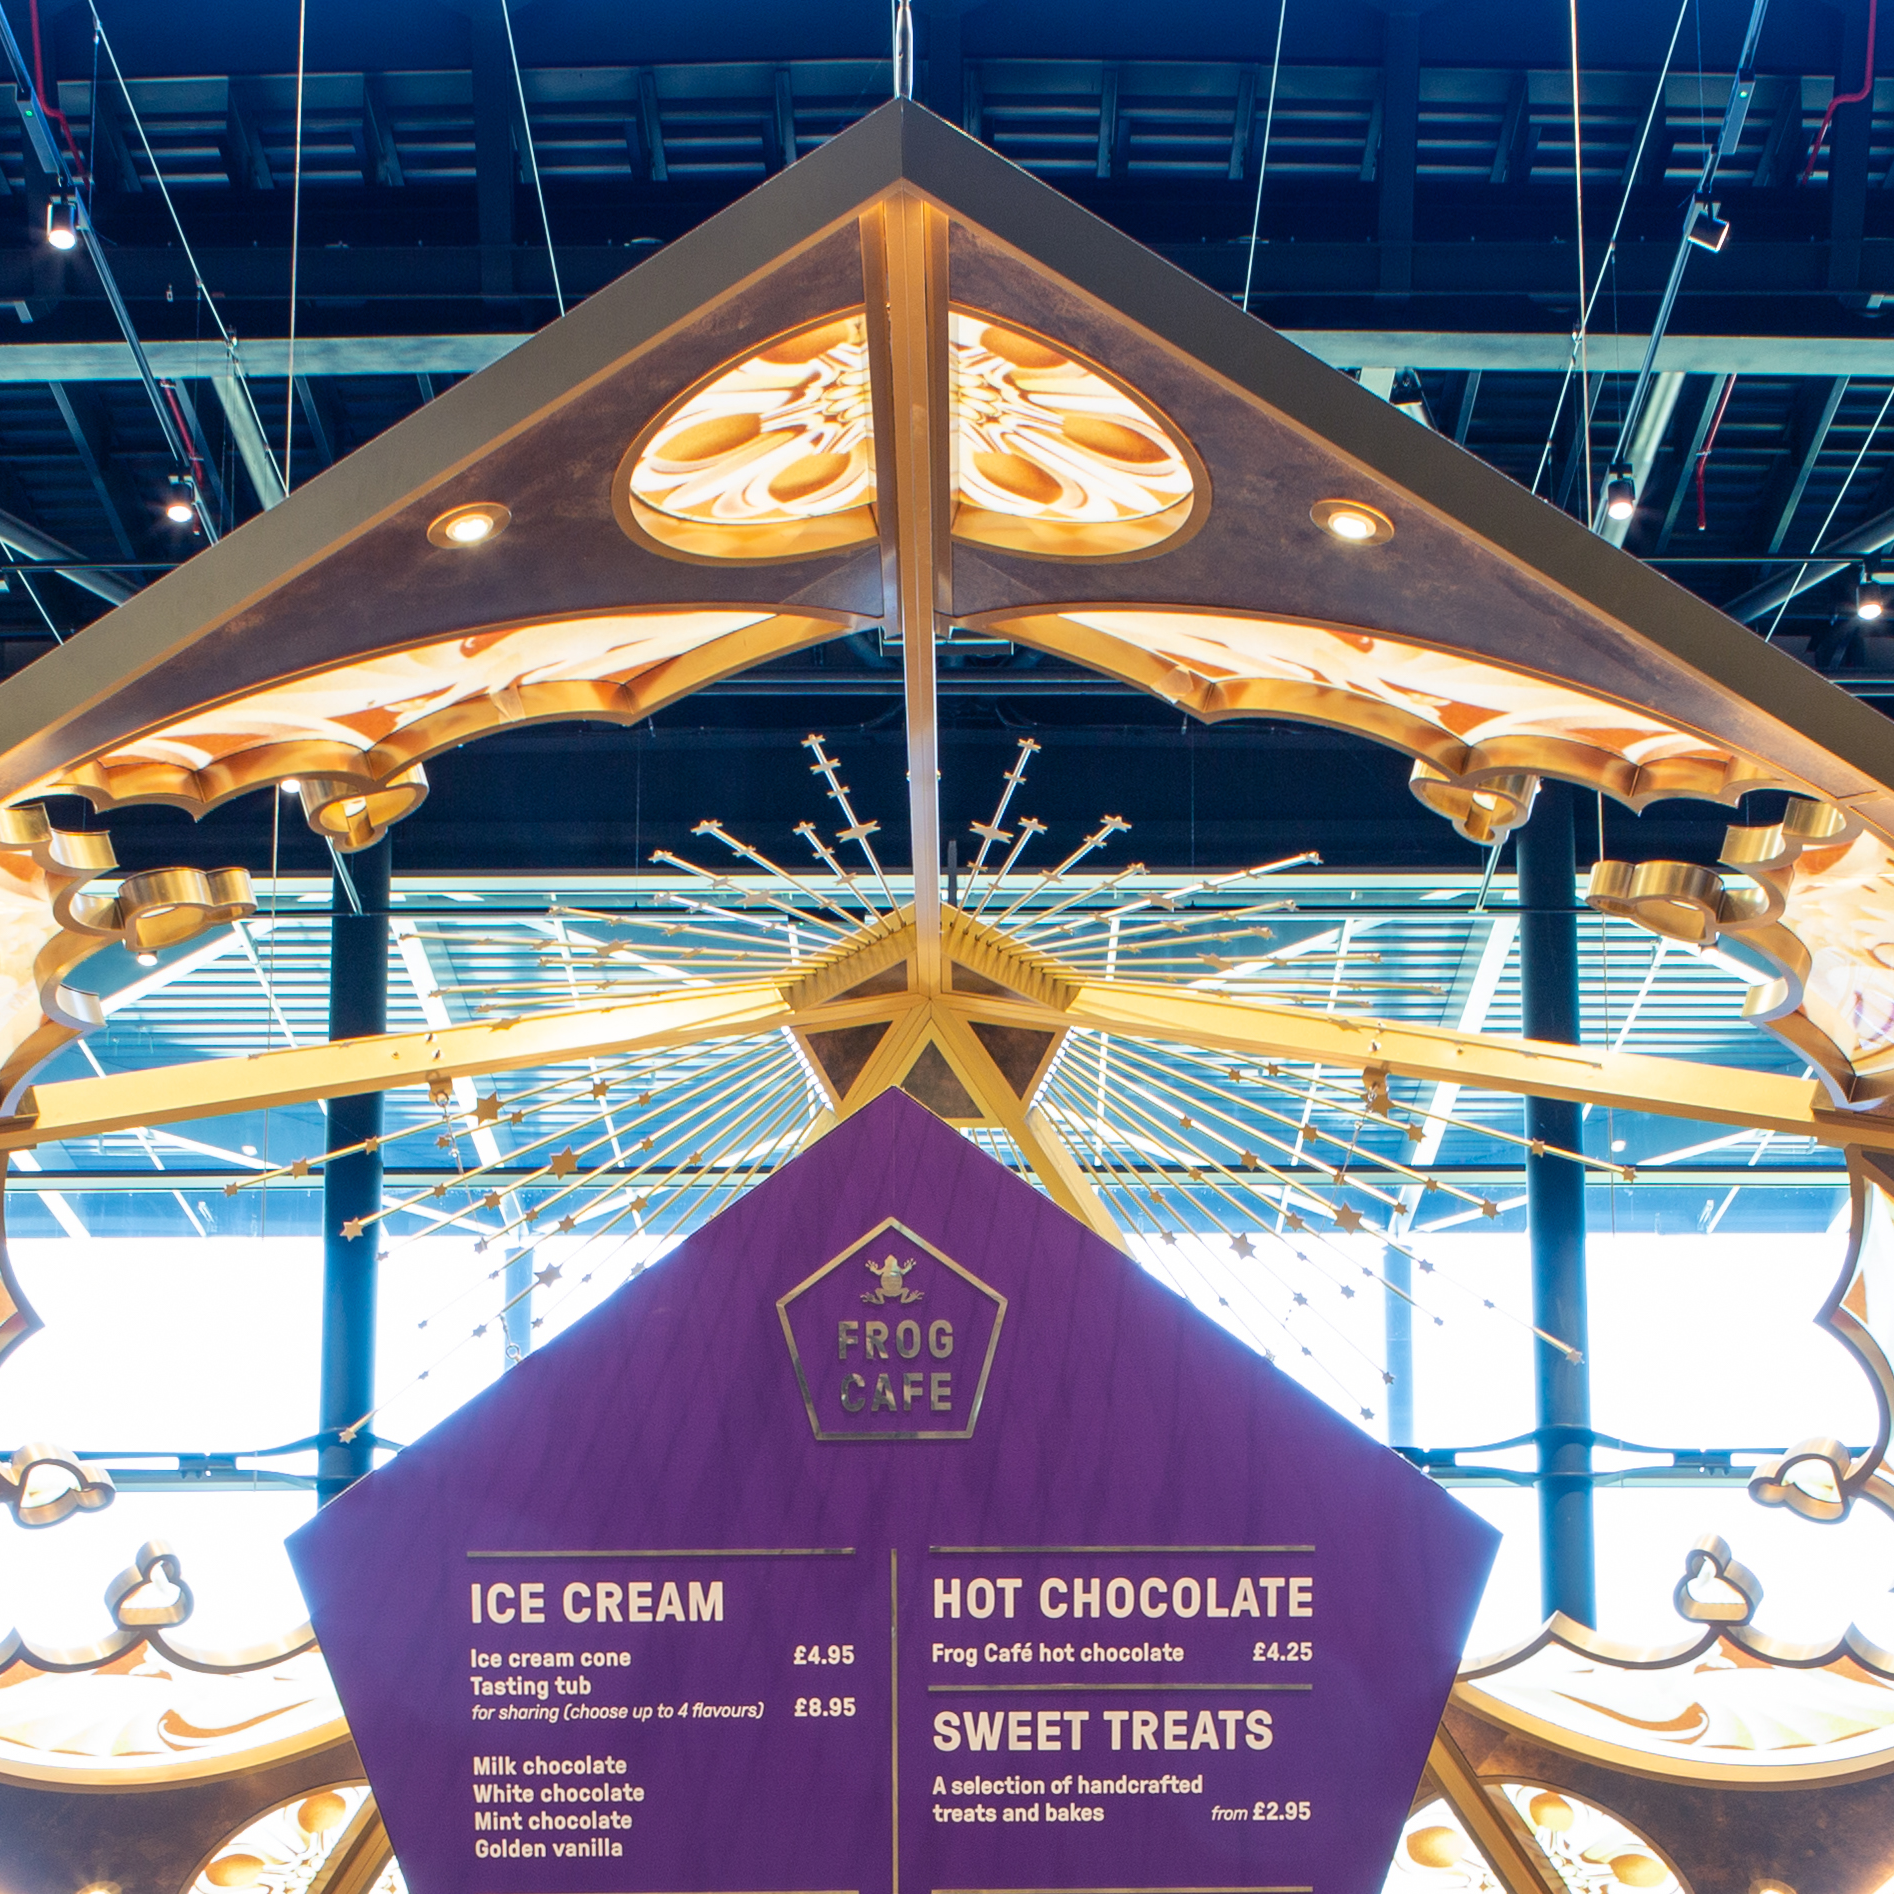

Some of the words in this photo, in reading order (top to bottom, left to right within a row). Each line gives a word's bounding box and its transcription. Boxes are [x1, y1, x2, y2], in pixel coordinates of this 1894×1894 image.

[838, 1319, 954, 1359] FROG
[841, 1373, 952, 1412] CAFE
[470, 1582, 546, 1625] ICE
[562, 1580, 724, 1624] CREAM
[933, 1577, 1023, 1619] HOT
[1039, 1576, 1313, 1619] CHOCOLATE
[470, 1648, 503, 1669] Ice
[508, 1652, 575, 1668] cream
[580, 1651, 632, 1668] cone
[793, 1644, 855, 1665] £4.95
[932, 1643, 978, 1668] Frog
[984, 1641, 1033, 1663] Café
[1039, 1642, 1075, 1663] hot
[1080, 1642, 1185, 1663] chocolate
[1252, 1641, 1313, 1662] £4.25
[469, 1675, 549, 1700] Tasting
[554, 1674, 592, 1696] tub
[471, 1703, 494, 1721] for
[498, 1704, 561, 1724] sharing
[563, 1702, 629, 1722] (choose
[632, 1706, 654, 1723] up
[657, 1702, 675, 1719] to
[677, 1701, 689, 1719] 4
[692, 1701, 765, 1720] flavours)
[794, 1696, 857, 1718] £8.95
[933, 1710, 1090, 1752] SWEET
[1102, 1709, 1274, 1751] TREATS
[473, 1755, 517, 1776] Milk
[522, 1754, 628, 1776] chocolate
[472, 1783, 534, 1804] White
[539, 1782, 646, 1803] chocolate
[932, 1775, 947, 1795] A
[951, 1775, 1046, 1796] selection
[1050, 1774, 1073, 1795] of
[1077, 1774, 1203, 1795] handcrafted
[474, 1811, 523, 1831] Mint
[527, 1809, 633, 1831] chocolate
[932, 1803, 998, 1823] treats
[1002, 1802, 1040, 1823] and
[1045, 1802, 1105, 1822] bakes
[1211, 1804, 1249, 1821] from
[1252, 1801, 1312, 1821] £2.95
[475, 1838, 547, 1859] Golden
[552, 1837, 623, 1858] vanilla
